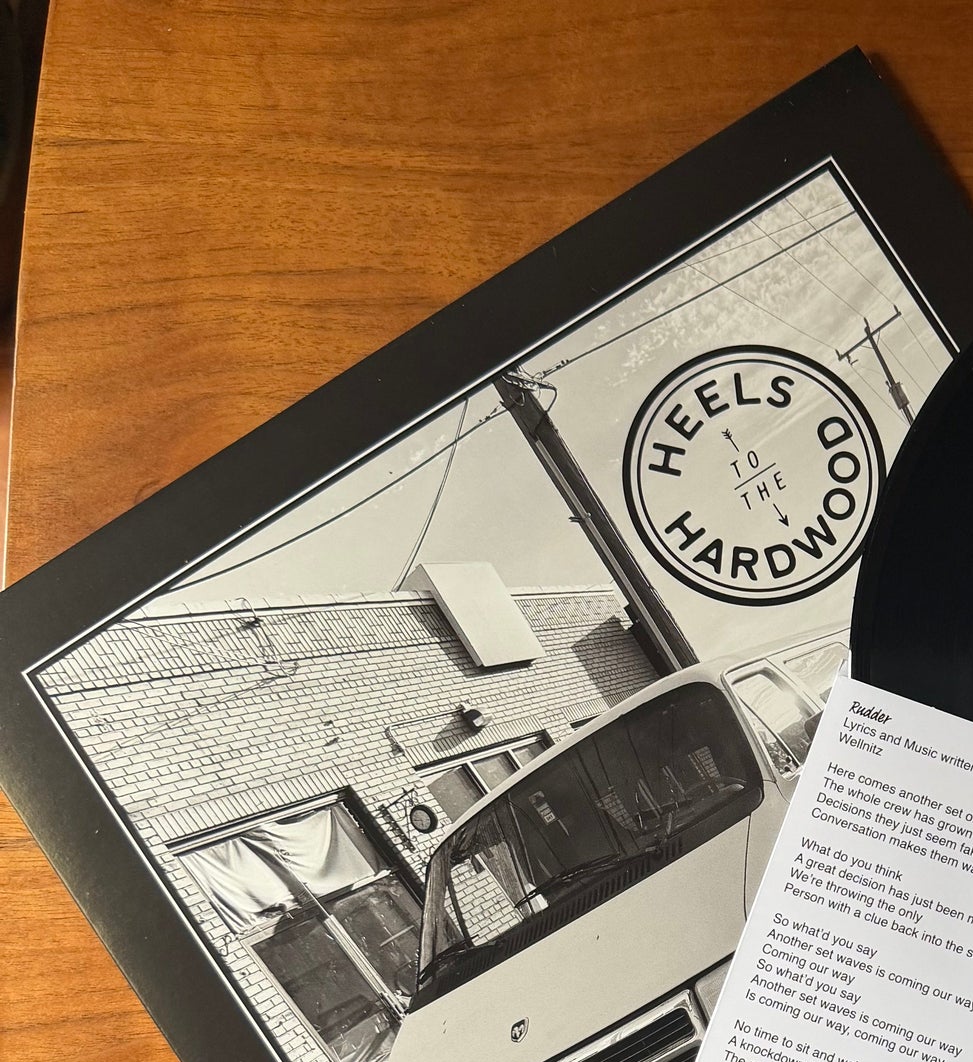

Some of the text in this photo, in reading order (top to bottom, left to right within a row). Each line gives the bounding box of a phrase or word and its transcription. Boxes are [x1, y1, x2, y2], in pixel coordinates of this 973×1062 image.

[648, 373, 794, 477] HEELS
[730, 451, 759, 478] TO
[665, 416, 860, 581] HARDWOOD
[740, 471, 787, 510] THE
[848, 701, 892, 725] Rudder
[839, 732, 883, 756] Wellnitz
[843, 717, 877, 737] Lyrics
[879, 732, 902, 746] and
[904, 738, 938, 759] Music
[827, 762, 855, 780] Here
[858, 775, 896, 795] comes
[898, 789, 943, 811] another
[945, 806, 963, 818] set
[816, 792, 872, 820] Decisions
[875, 813, 901, 831] they
[900, 821, 923, 838] just
[925, 832, 957, 850] seem
